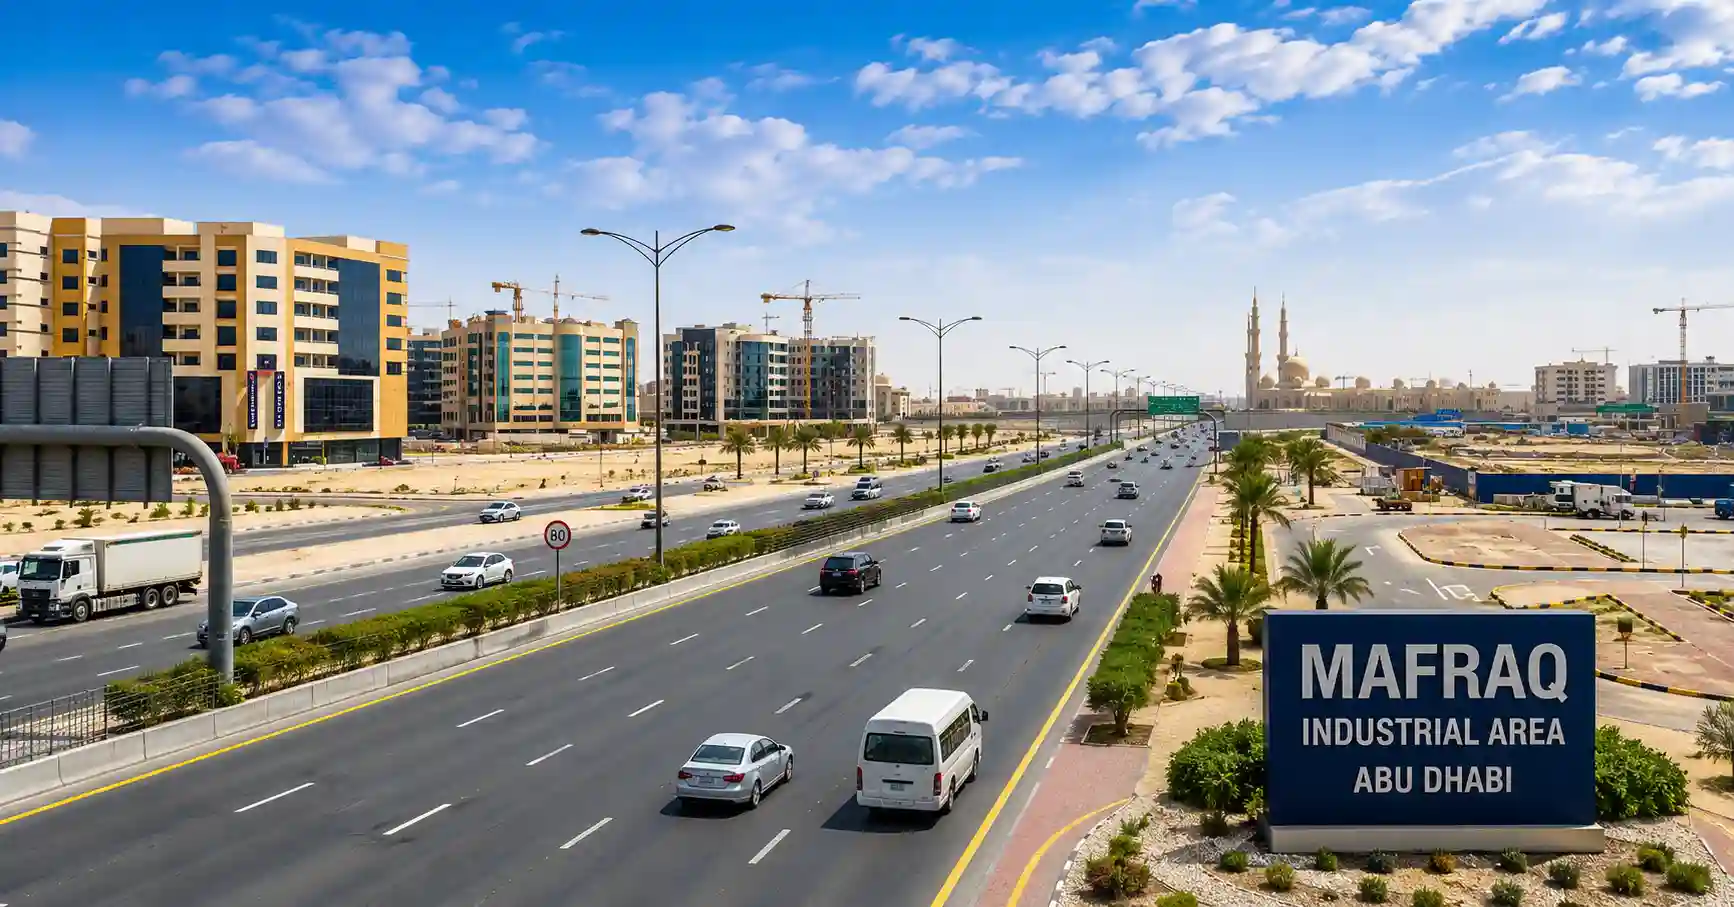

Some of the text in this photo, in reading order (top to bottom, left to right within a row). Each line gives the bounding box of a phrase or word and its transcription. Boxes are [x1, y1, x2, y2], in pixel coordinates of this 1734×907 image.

[551, 529, 565, 541] 80
[1301, 643, 1568, 703] MAFRAQ
[1302, 717, 1566, 746] INDUSTRIAL AREA
[1353, 766, 1512, 794] ABU DHABI
